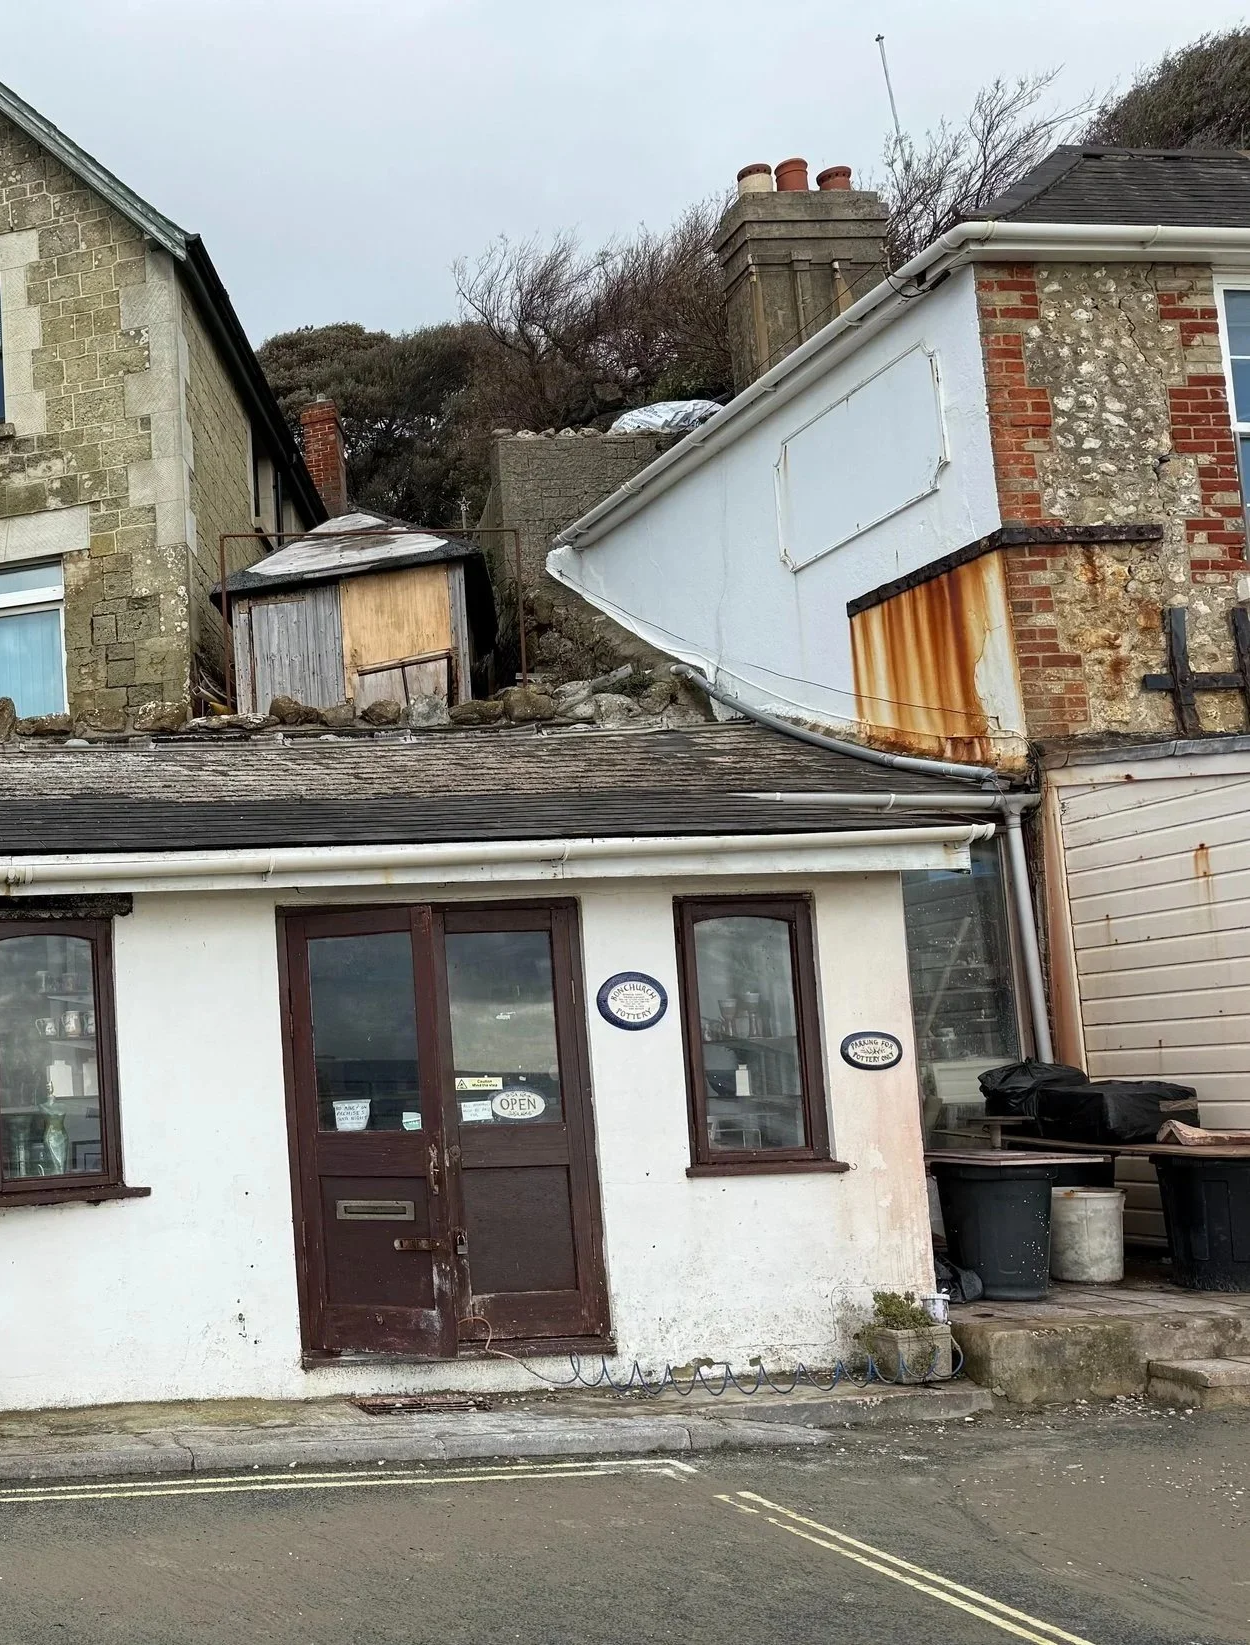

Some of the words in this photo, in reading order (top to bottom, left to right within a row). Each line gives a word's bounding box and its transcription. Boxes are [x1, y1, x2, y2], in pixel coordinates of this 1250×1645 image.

[610, 983, 657, 1001] BONCHURCH
[616, 1007, 651, 1020] POTTERY
[850, 1039, 879, 1050] PARKING
[880, 1040, 893, 1050] FOR
[852, 1051, 880, 1063] POTTERY
[880, 1052, 894, 1062] ONLY
[499, 1097, 537, 1111] OPEN
